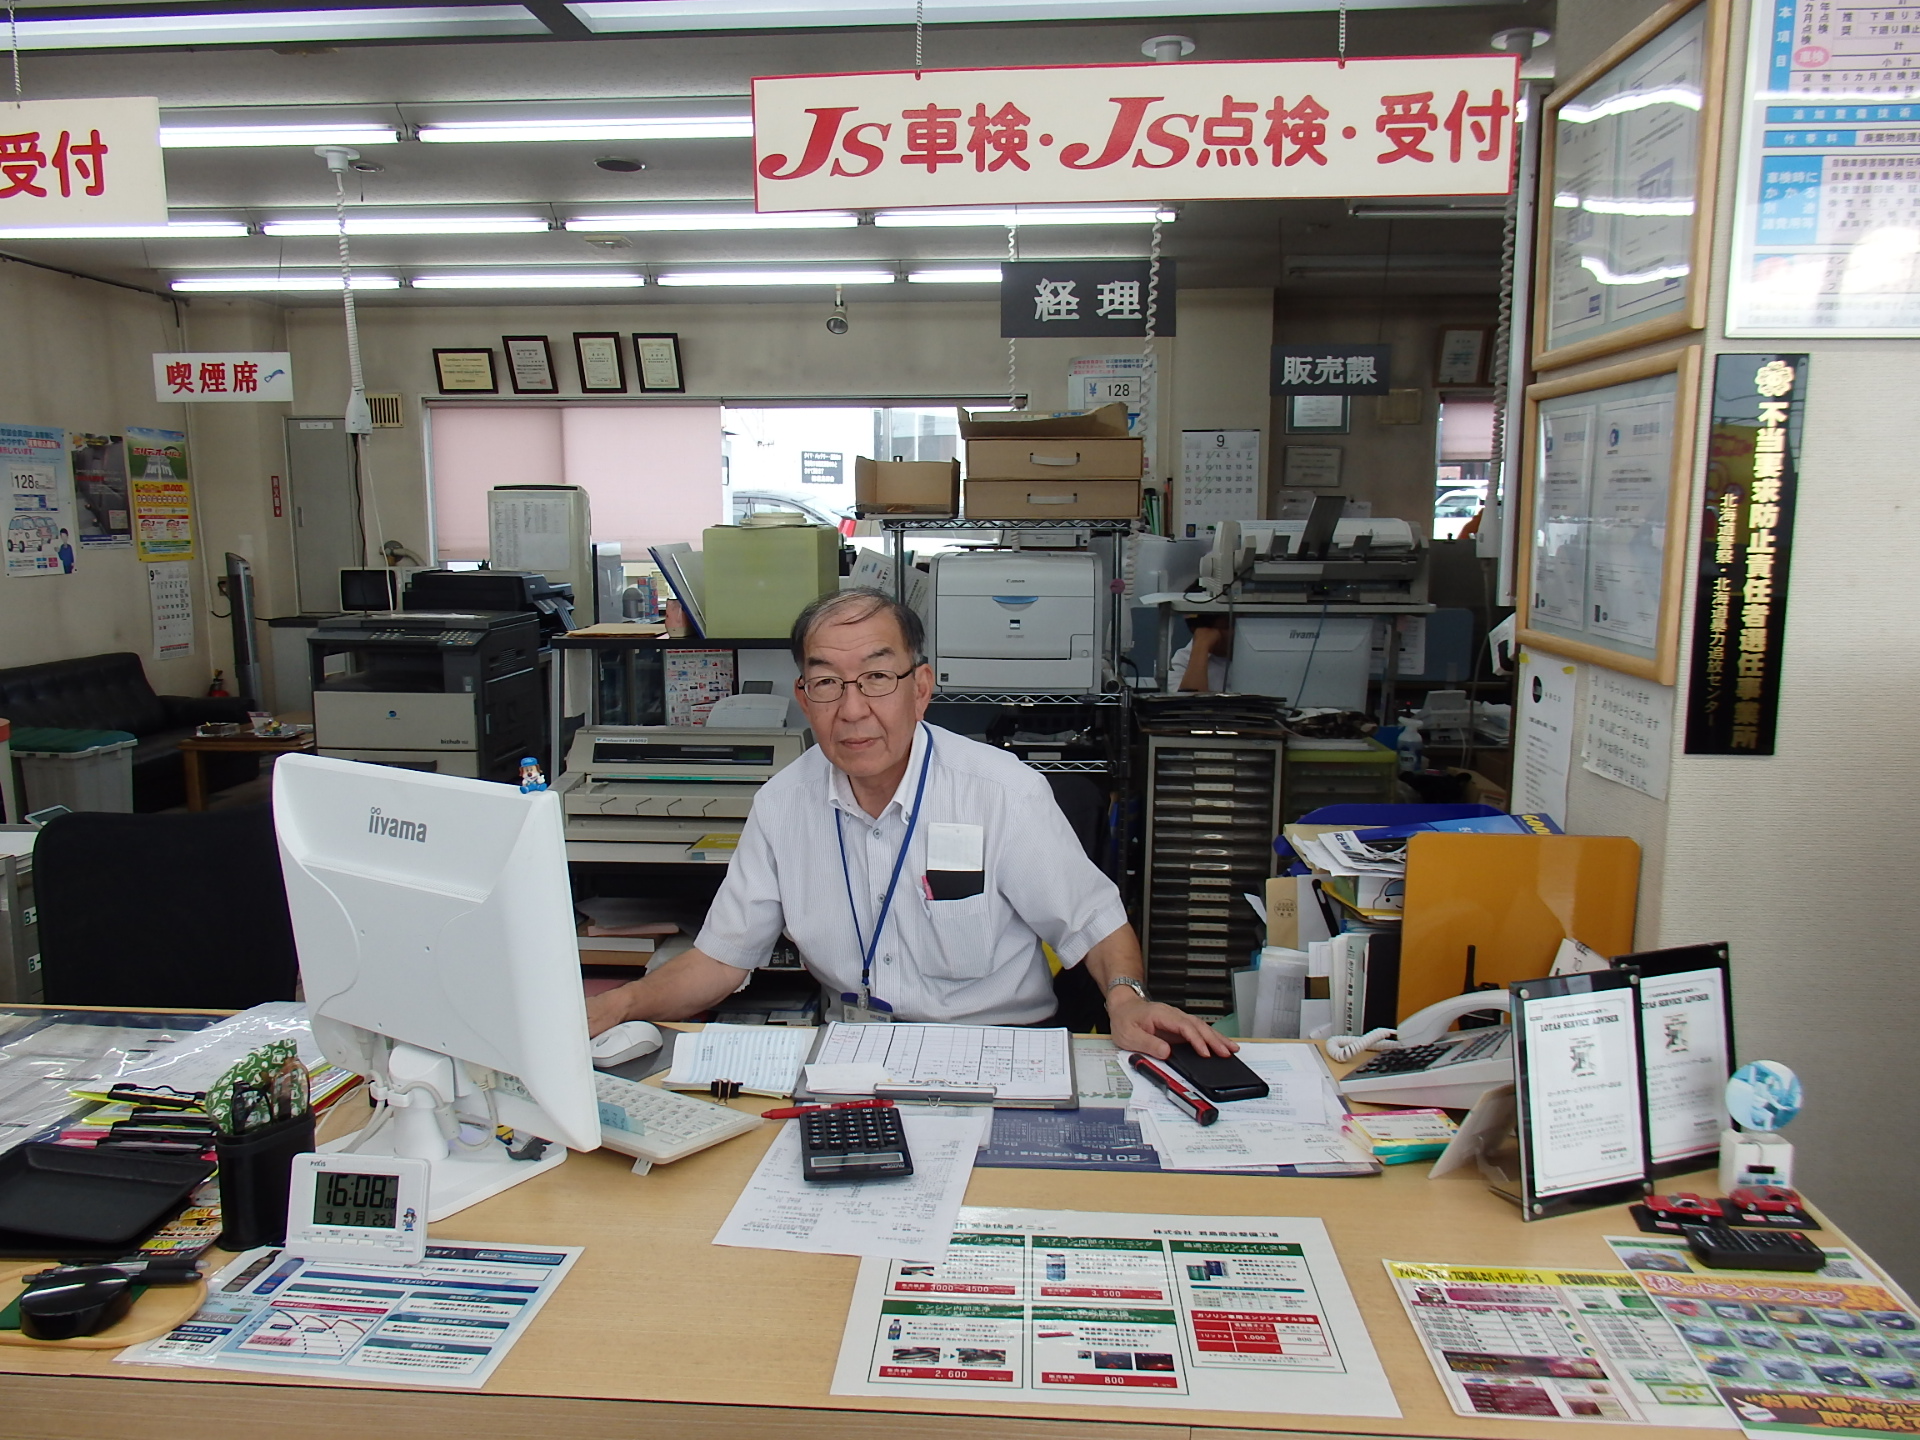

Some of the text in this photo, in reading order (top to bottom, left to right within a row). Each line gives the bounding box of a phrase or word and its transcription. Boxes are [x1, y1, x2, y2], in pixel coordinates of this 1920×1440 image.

[0, 130, 108, 198] 受付
[1831, 171, 1920, 181] 自動車重量税印
[1034, 278, 1142, 322] 経理
[165, 361, 259, 395] 喫煙席
[1281, 356, 1378, 385] 販売課
[1107, 384, 1130, 397] 128
[1216, 434, 1225, 447] 9
[14, 474, 34, 489] 128
[369, 806, 427, 843] iiyama
[1659, 997, 1683, 1007] SERVICE
[1684, 993, 1709, 1005] ADVISER
[1540, 1014, 1619, 1033] LOTAS SERVICE ADVISER
[326, 1174, 387, 1208] 16:08
[326, 1211, 333, 1223] 9
[344, 1212, 350, 1224] 9
[354, 1211, 366, 1225] 月
[1153, 1228, 1193, 1236] 株式会社
[1104, 1376, 1124, 1384] 800
